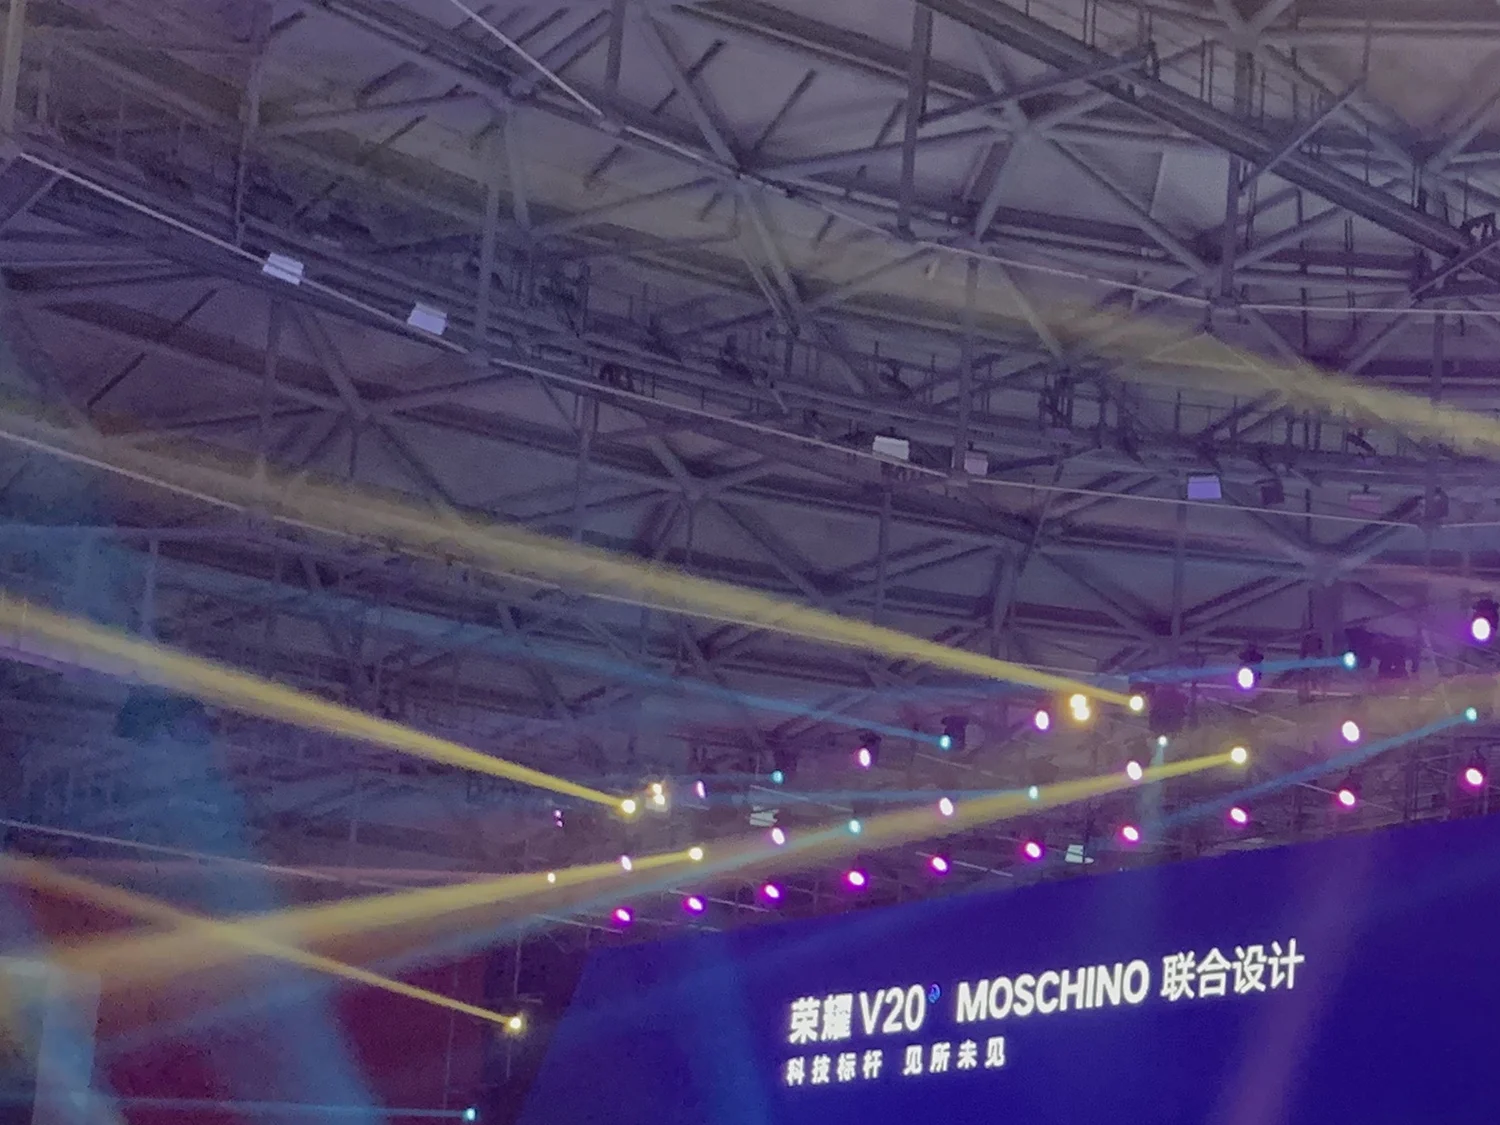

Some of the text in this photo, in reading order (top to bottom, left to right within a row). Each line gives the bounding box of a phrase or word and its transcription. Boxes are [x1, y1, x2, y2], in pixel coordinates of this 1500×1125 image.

[789, 938, 1305, 1044] 荣耀 V20 MOSCHINO 联合设计
[786, 1036, 1005, 1087] 科技标杆 见所未见
